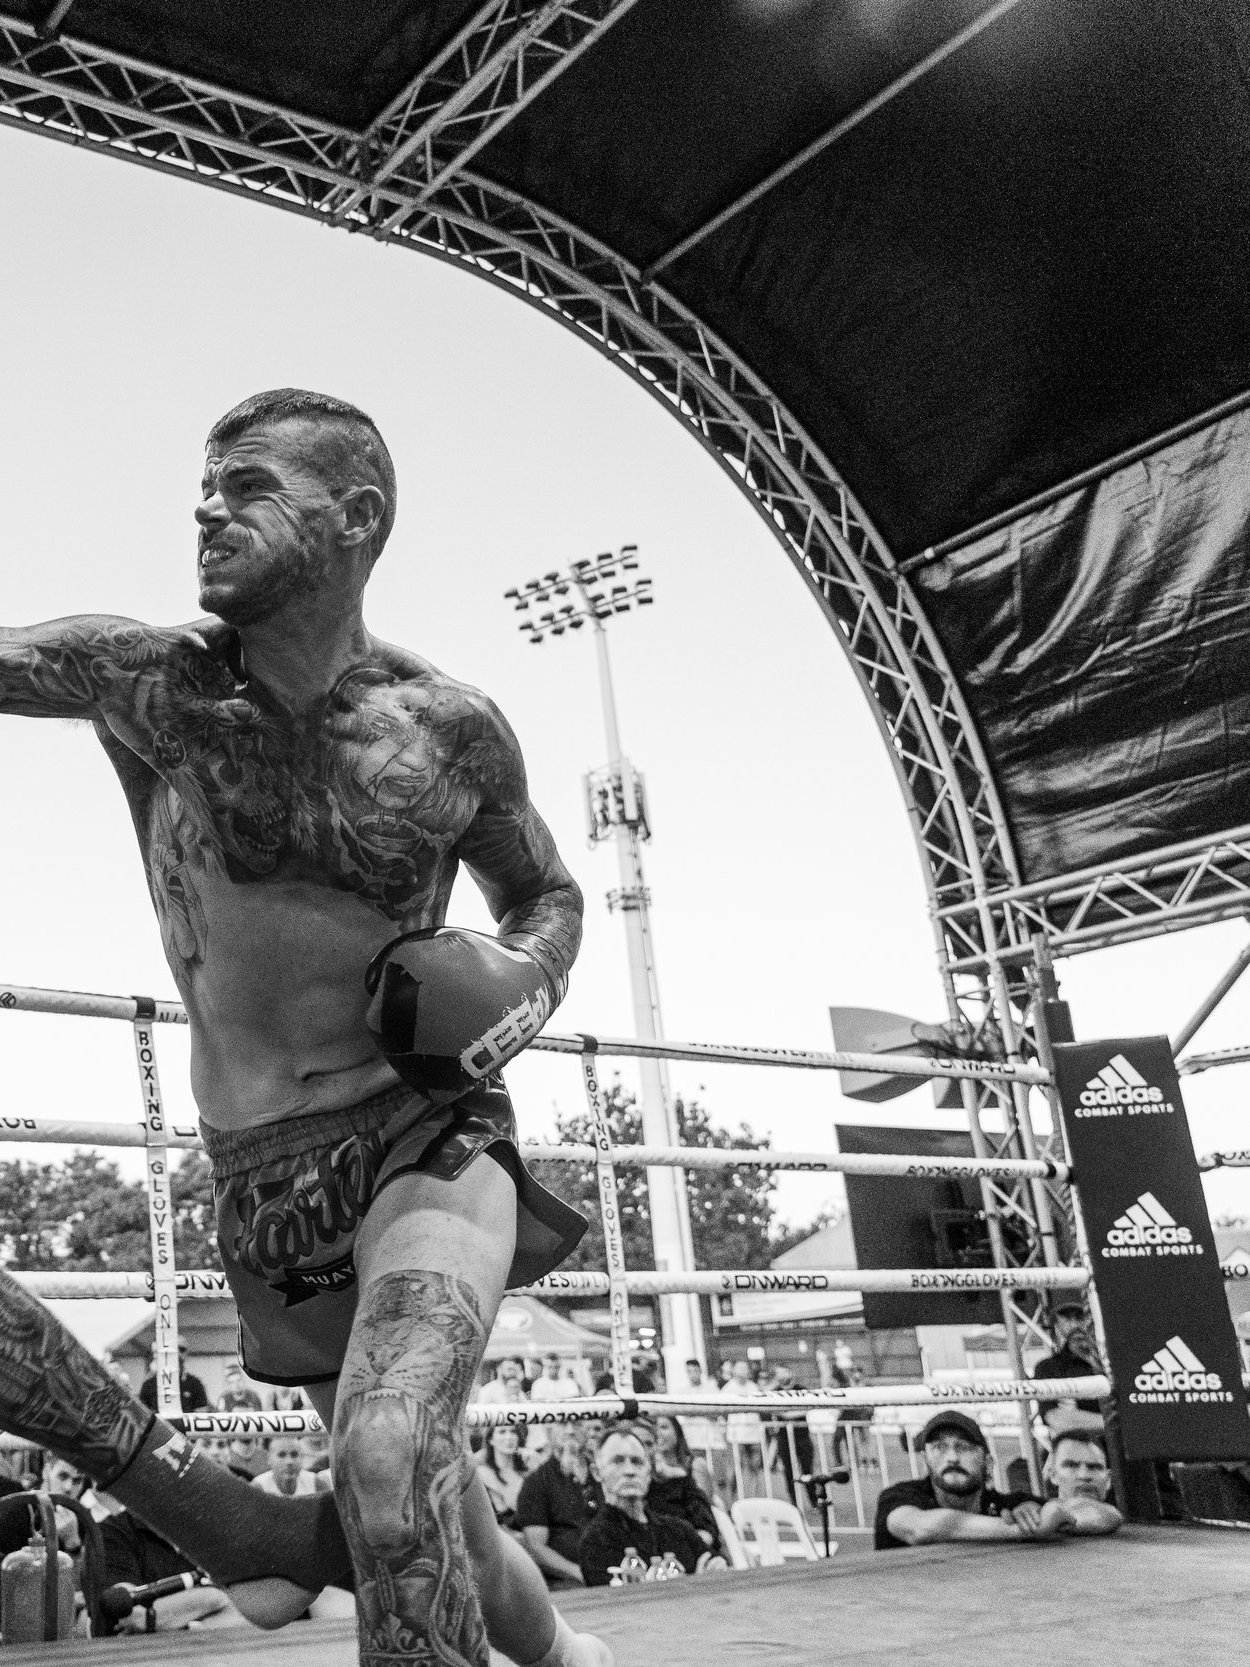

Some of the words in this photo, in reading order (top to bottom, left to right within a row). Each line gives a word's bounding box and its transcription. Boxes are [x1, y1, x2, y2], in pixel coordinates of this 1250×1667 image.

[138, 1031, 163, 1132] BOXING
[1079, 1085, 1163, 1106] adidas
[1074, 1105, 1123, 1118] COMBAT
[1127, 1103, 1175, 1115] SPORTS
[585, 1065, 610, 1151] BOXING
[601, 1176, 620, 1267] GLOVES
[151, 1161, 169, 1264] GLOVES
[1106, 1225, 1193, 1246] adidas
[1101, 1246, 1151, 1258] COMBAT
[1155, 1244, 1204, 1256] SPORTS
[735, 1274, 828, 1290] ONWARD
[159, 1294, 173, 1403] ONLINE
[1134, 1369, 1222, 1391] adidas
[1129, 1392, 1180, 1404] COMBAT
[1184, 1391, 1233, 1403] SPORTS
